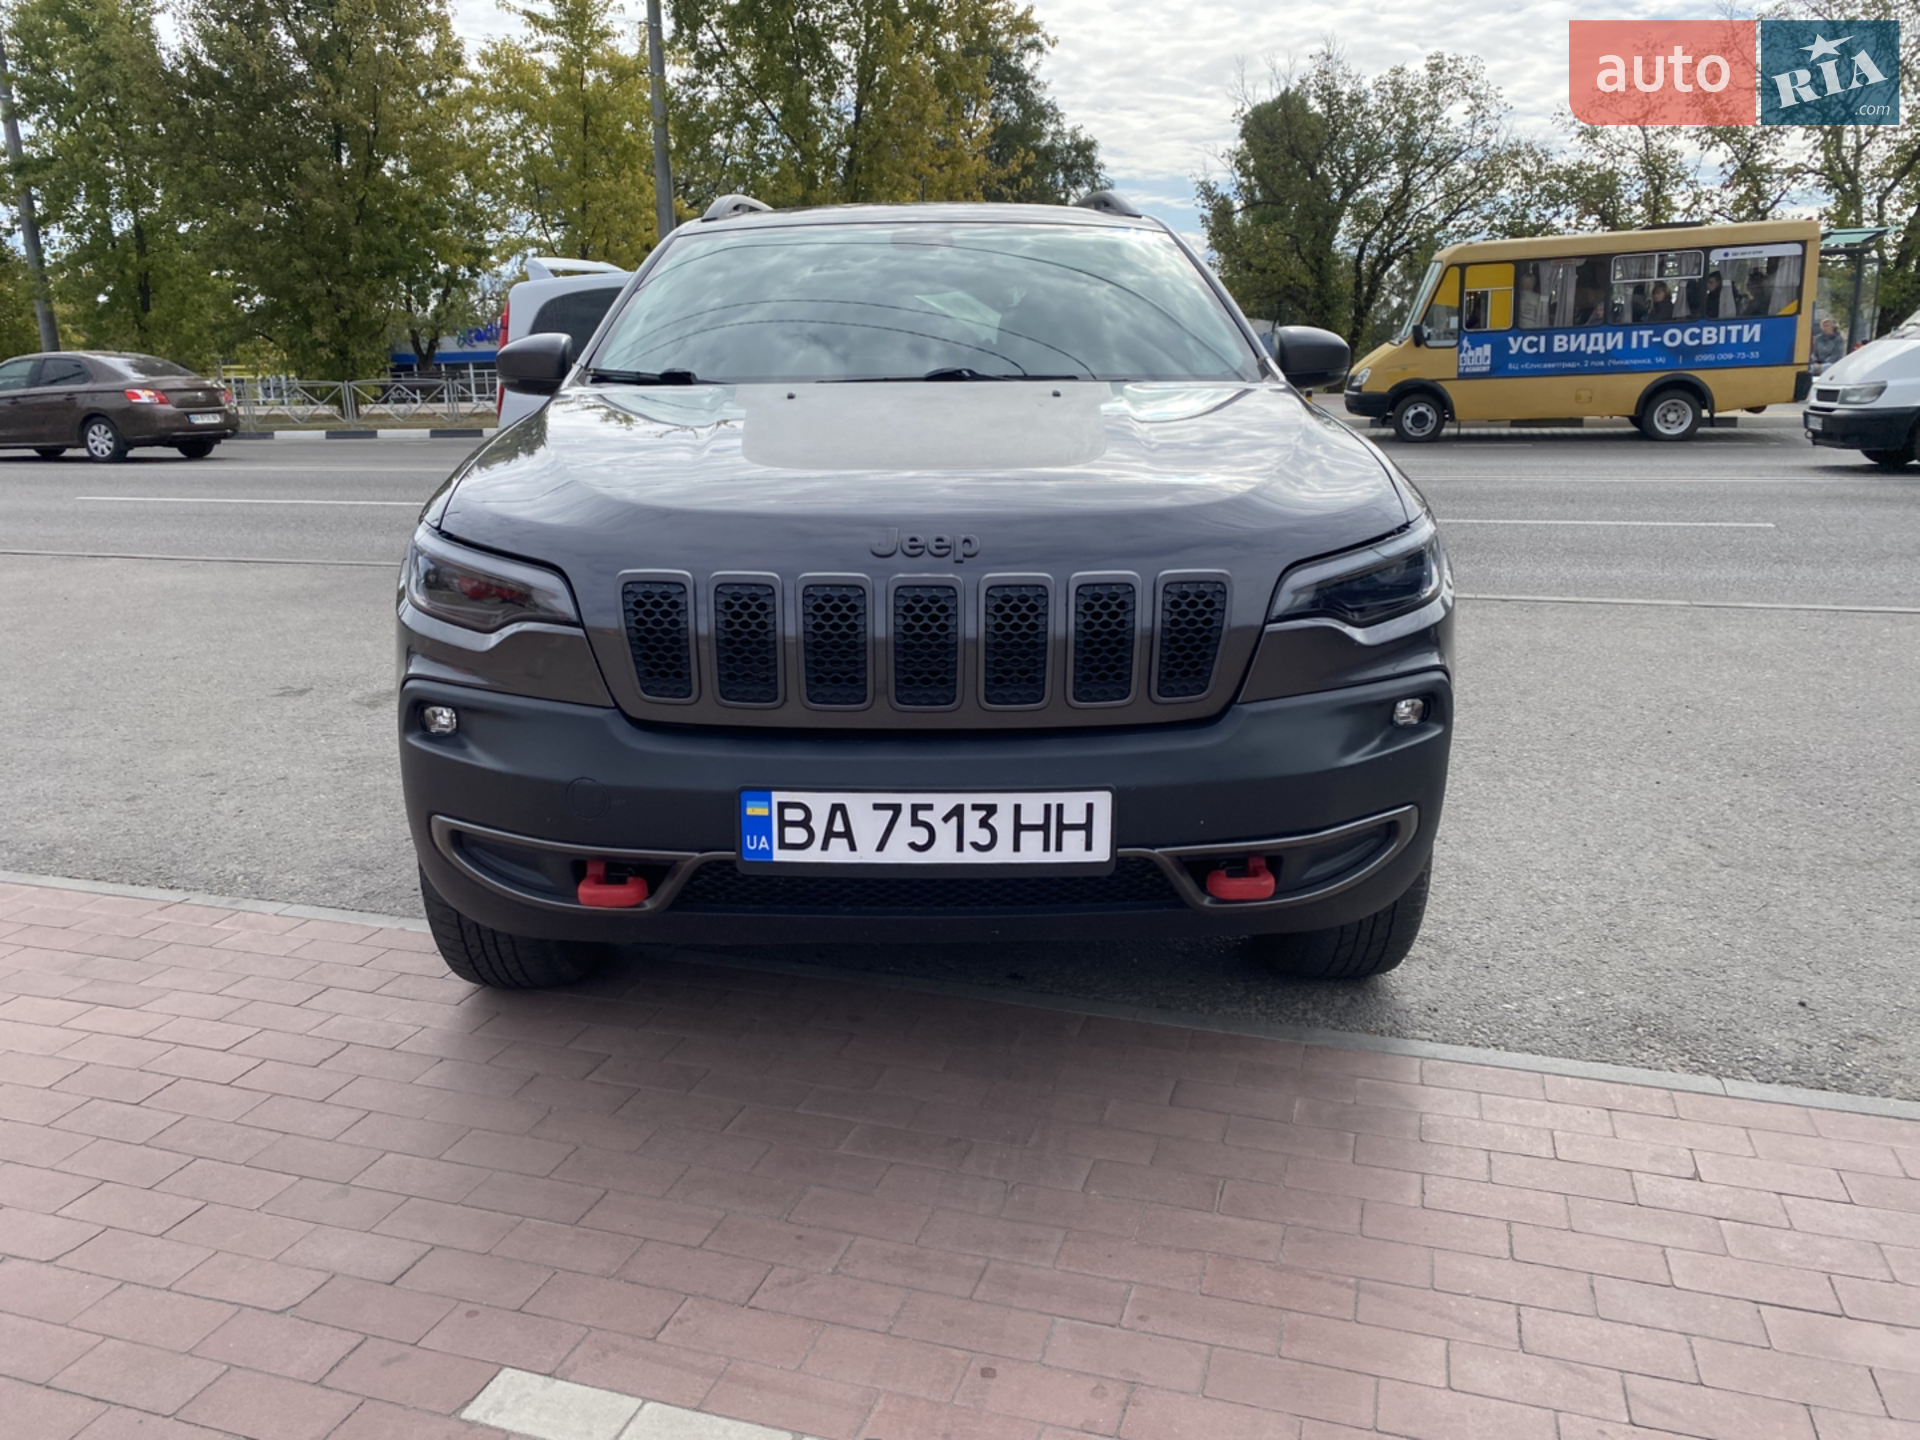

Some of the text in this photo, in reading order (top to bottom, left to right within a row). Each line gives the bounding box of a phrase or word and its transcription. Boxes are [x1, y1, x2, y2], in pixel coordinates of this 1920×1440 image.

[1508, 335, 1546, 354] УСІ
[1553, 331, 1623, 354] ВИДИ
[1694, 353, 1716, 362] (095)
[869, 527, 980, 563] Jeep
[776, 801, 1095, 853] BA 7513 HH
[746, 835, 770, 851] UA
